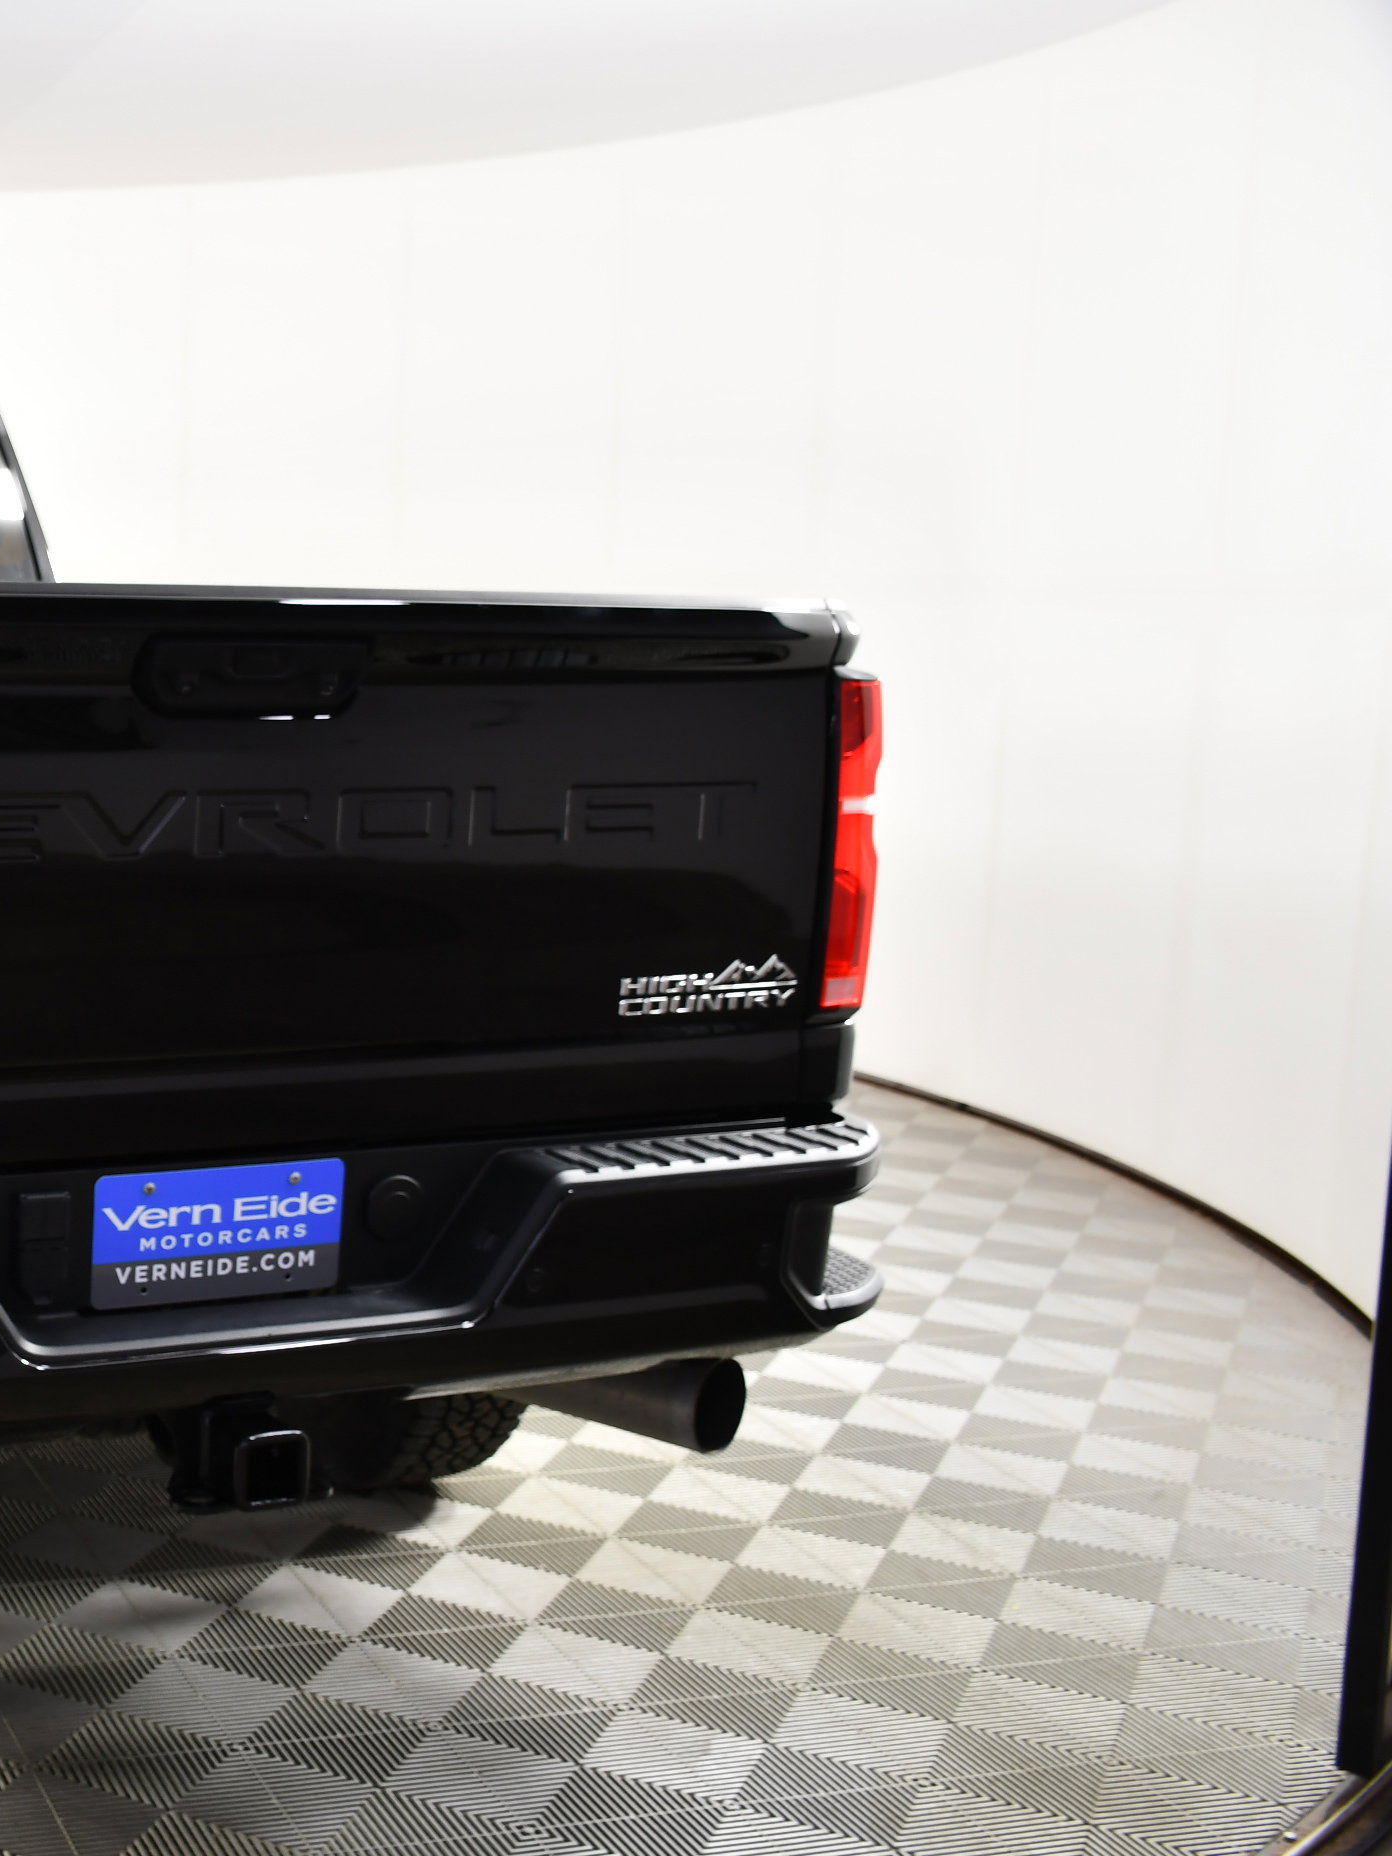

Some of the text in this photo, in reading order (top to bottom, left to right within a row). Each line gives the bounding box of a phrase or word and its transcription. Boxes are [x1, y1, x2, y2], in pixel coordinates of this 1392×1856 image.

[619, 972, 714, 996] HIGH
[618, 987, 796, 1016] COUNTRY
[102, 1191, 337, 1232] Vern Eide
[139, 1222, 308, 1252] MOTORCARS
[115, 1249, 316, 1285] VERNEIDE.COM
